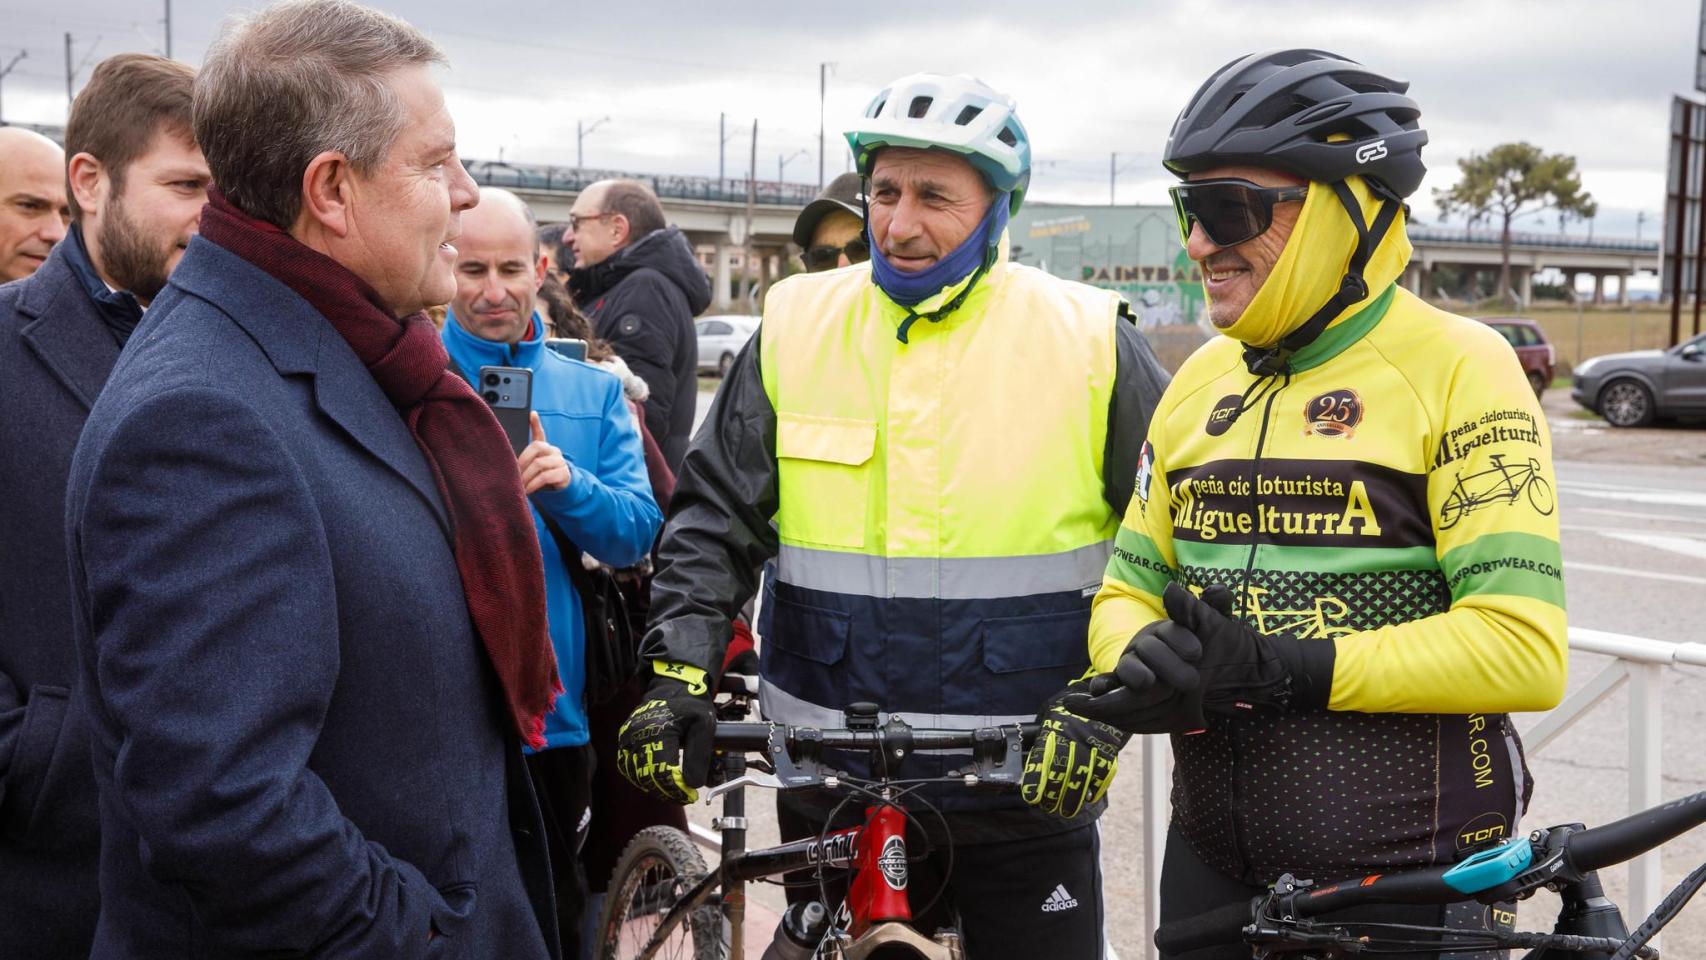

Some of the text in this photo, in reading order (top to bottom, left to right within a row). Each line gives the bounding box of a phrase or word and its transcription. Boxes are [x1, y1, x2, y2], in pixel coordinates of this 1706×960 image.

[1316, 395, 1352, 422] 25
[1450, 408, 1531, 442] peña cicloturista
[1192, 473, 1345, 499] peña cicloturista
[1169, 477, 1382, 540] MiguelturrA
[1041, 896, 1079, 912] adidas
